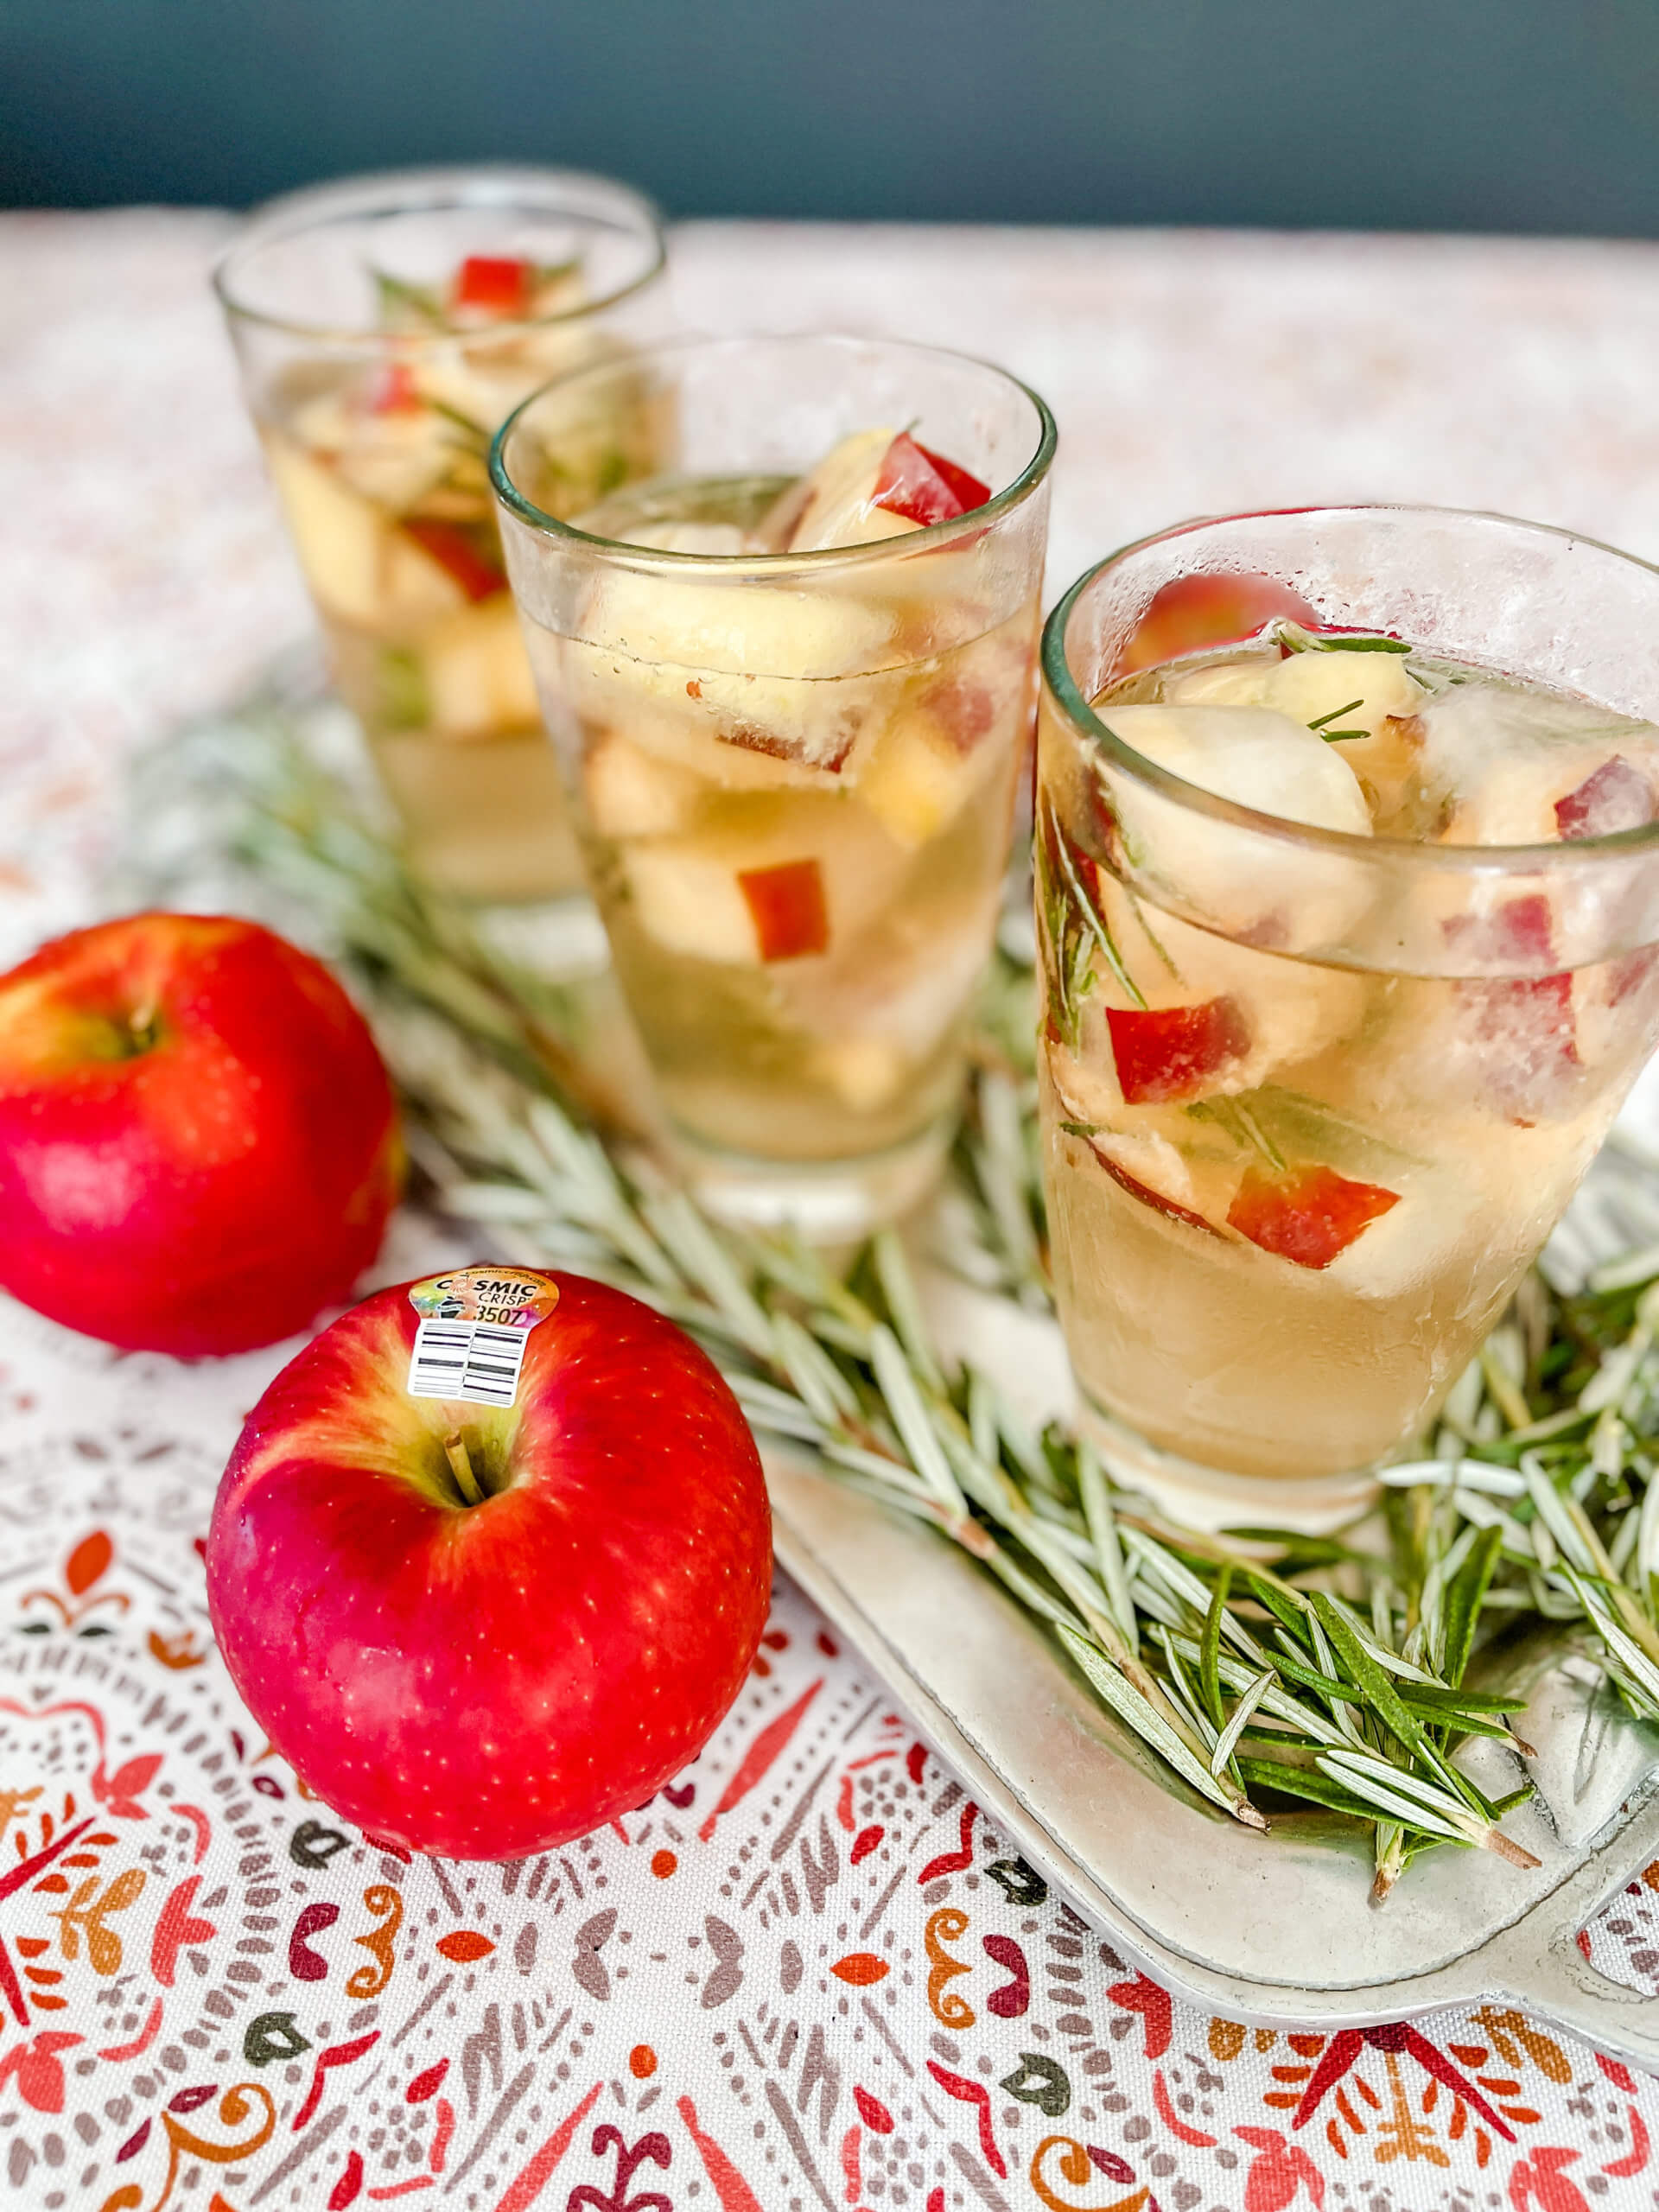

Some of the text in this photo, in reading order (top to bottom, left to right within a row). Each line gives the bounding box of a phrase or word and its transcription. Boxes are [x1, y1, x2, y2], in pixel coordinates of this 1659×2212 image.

[436, 1280, 537, 1297] COSMIC
[479, 1292, 526, 1306] CRISP
[474, 1305, 523, 1325] 3507
